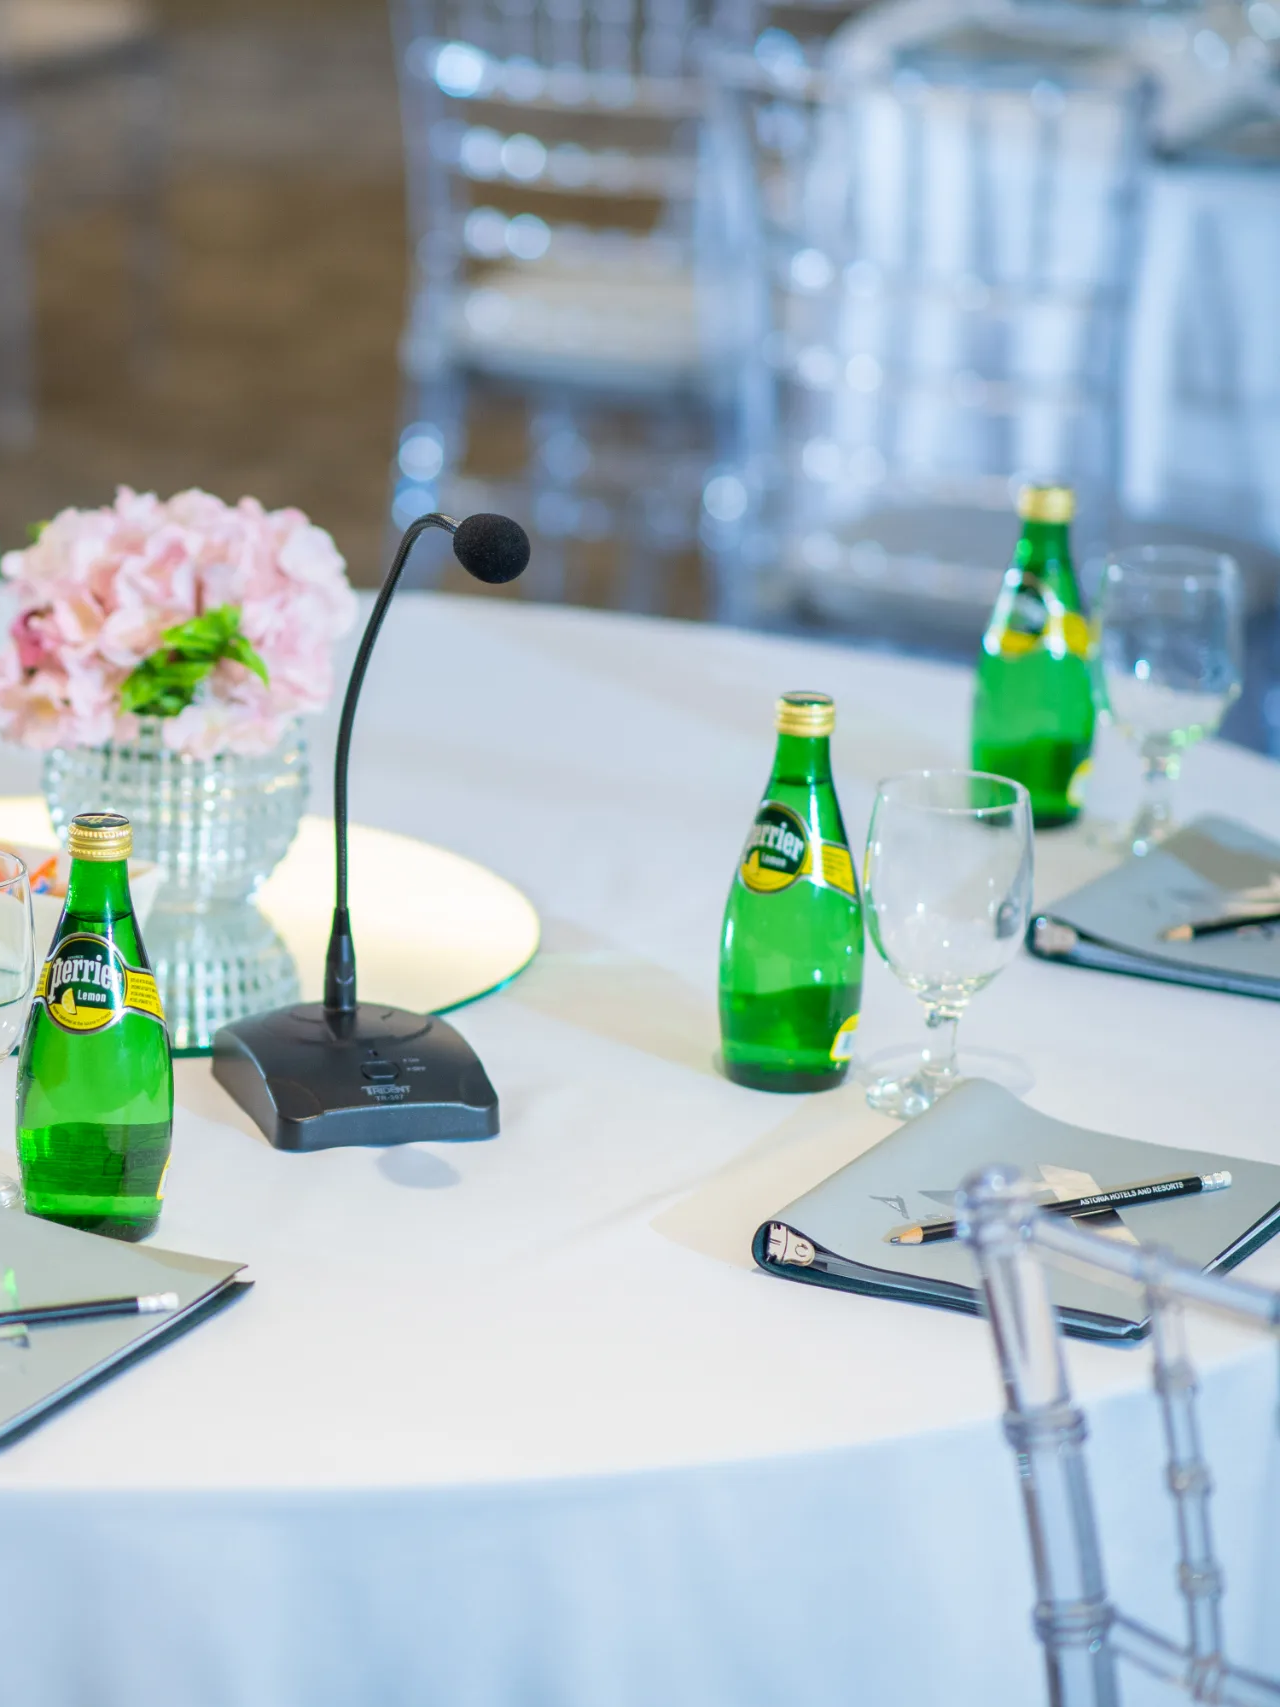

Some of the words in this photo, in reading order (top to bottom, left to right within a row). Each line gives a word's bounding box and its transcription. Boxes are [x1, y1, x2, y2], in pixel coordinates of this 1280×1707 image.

[77, 989, 107, 1003] Lemon
[361, 1084, 411, 1096] TRIDENT
[1079, 1194, 1110, 1206] ASTORIA
[1110, 1190, 1137, 1201] HOTELS
[1137, 1187, 1152, 1196] AND
[1152, 1181, 1184, 1193] RESORTS
